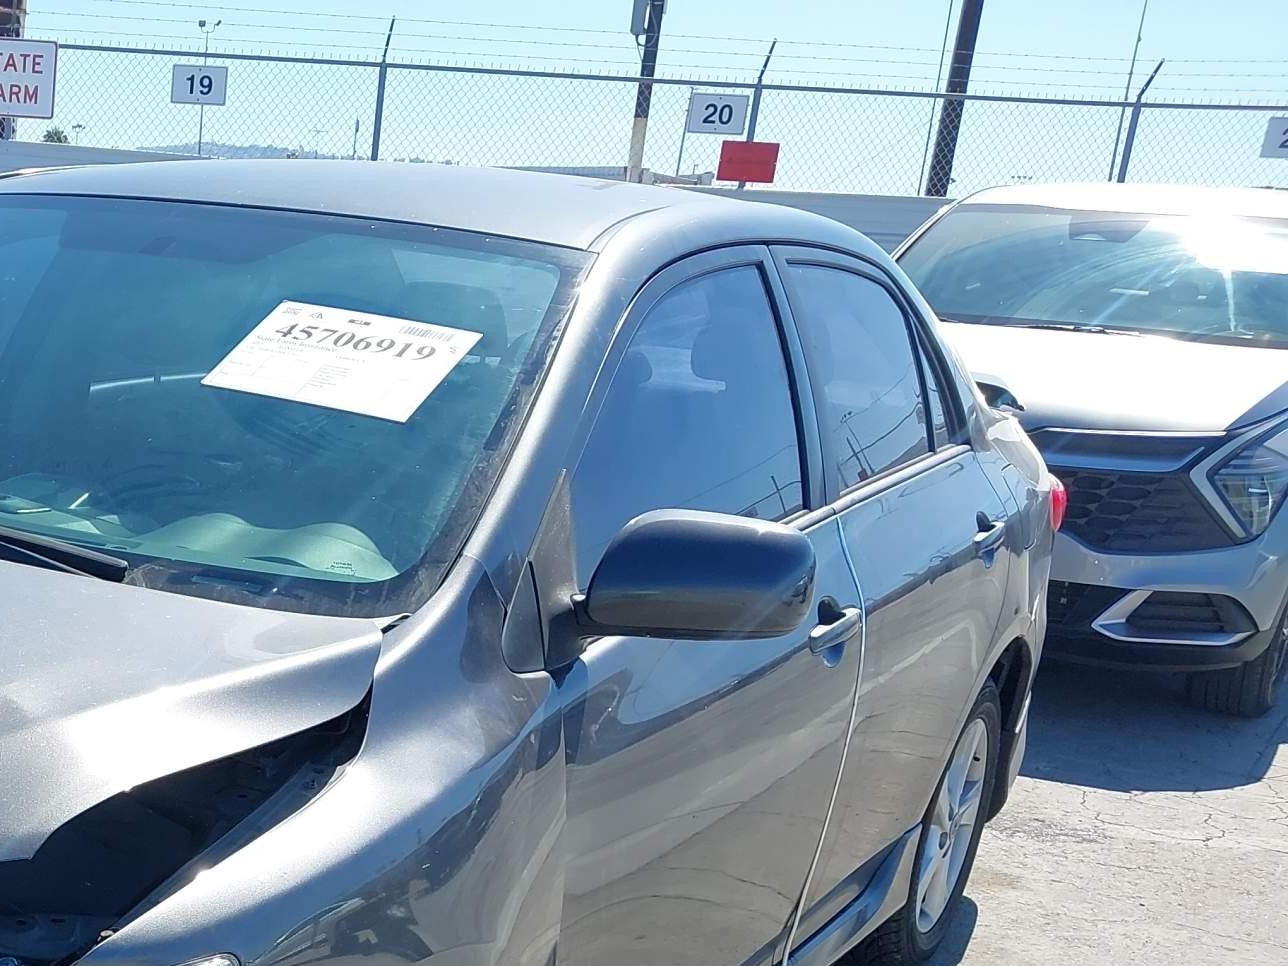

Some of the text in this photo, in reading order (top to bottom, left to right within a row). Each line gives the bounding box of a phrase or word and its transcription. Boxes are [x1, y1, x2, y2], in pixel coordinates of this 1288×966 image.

[185, 74, 213, 96] 19
[702, 103, 734, 125] 20
[275, 323, 436, 360] 45706919
